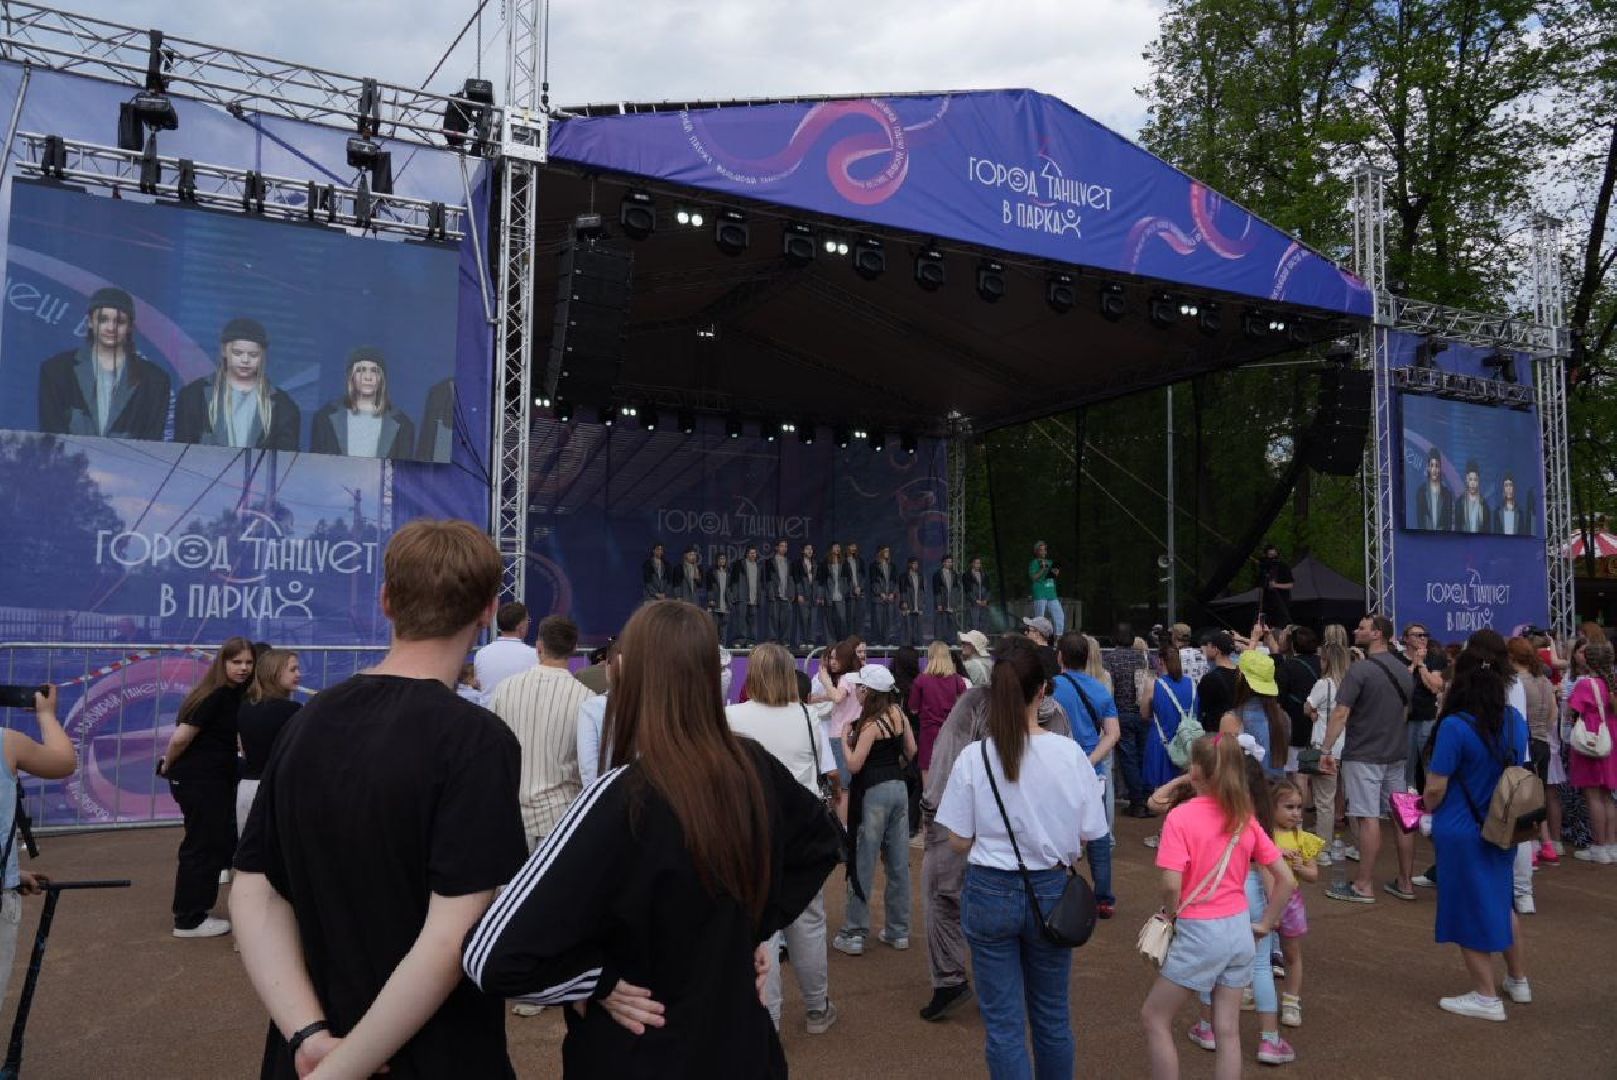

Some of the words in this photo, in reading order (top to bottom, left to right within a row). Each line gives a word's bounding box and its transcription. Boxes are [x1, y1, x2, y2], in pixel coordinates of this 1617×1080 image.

[969, 156, 1039, 197] ГОРОД
[1041, 163, 1113, 211] ТАНЦУЕТ
[1002, 199, 1013, 225] В
[657, 508, 732, 536] ГОРОД
[95, 529, 232, 572] ГОРОД
[239, 520, 379, 575] ТАНЦУЕТ
[159, 582, 178, 618] В
[1426, 582, 1470, 606] ГОРОД
[1447, 611, 1455, 632] В
